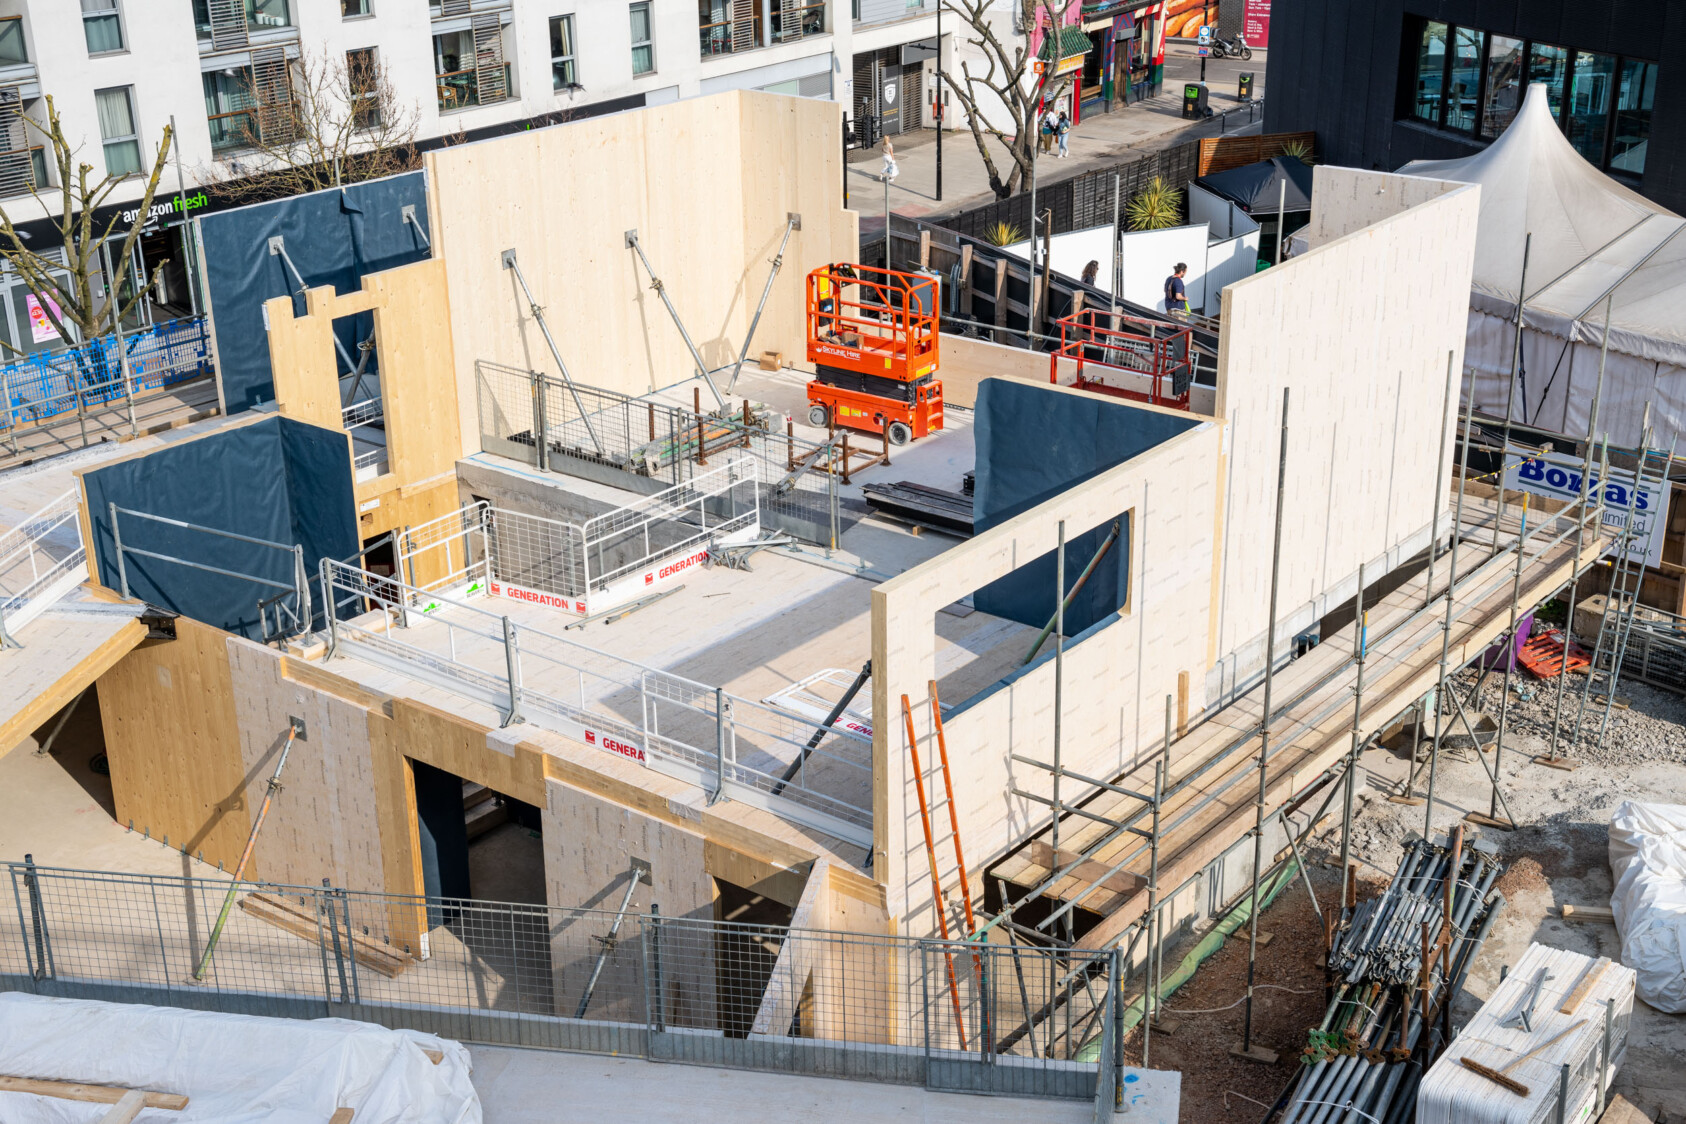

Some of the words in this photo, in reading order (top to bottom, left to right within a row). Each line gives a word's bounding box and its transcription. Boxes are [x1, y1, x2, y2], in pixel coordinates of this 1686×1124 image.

[659, 550, 709, 579] GENERATION
[507, 587, 569, 610] GENERATION
[603, 737, 646, 762] GENERA
